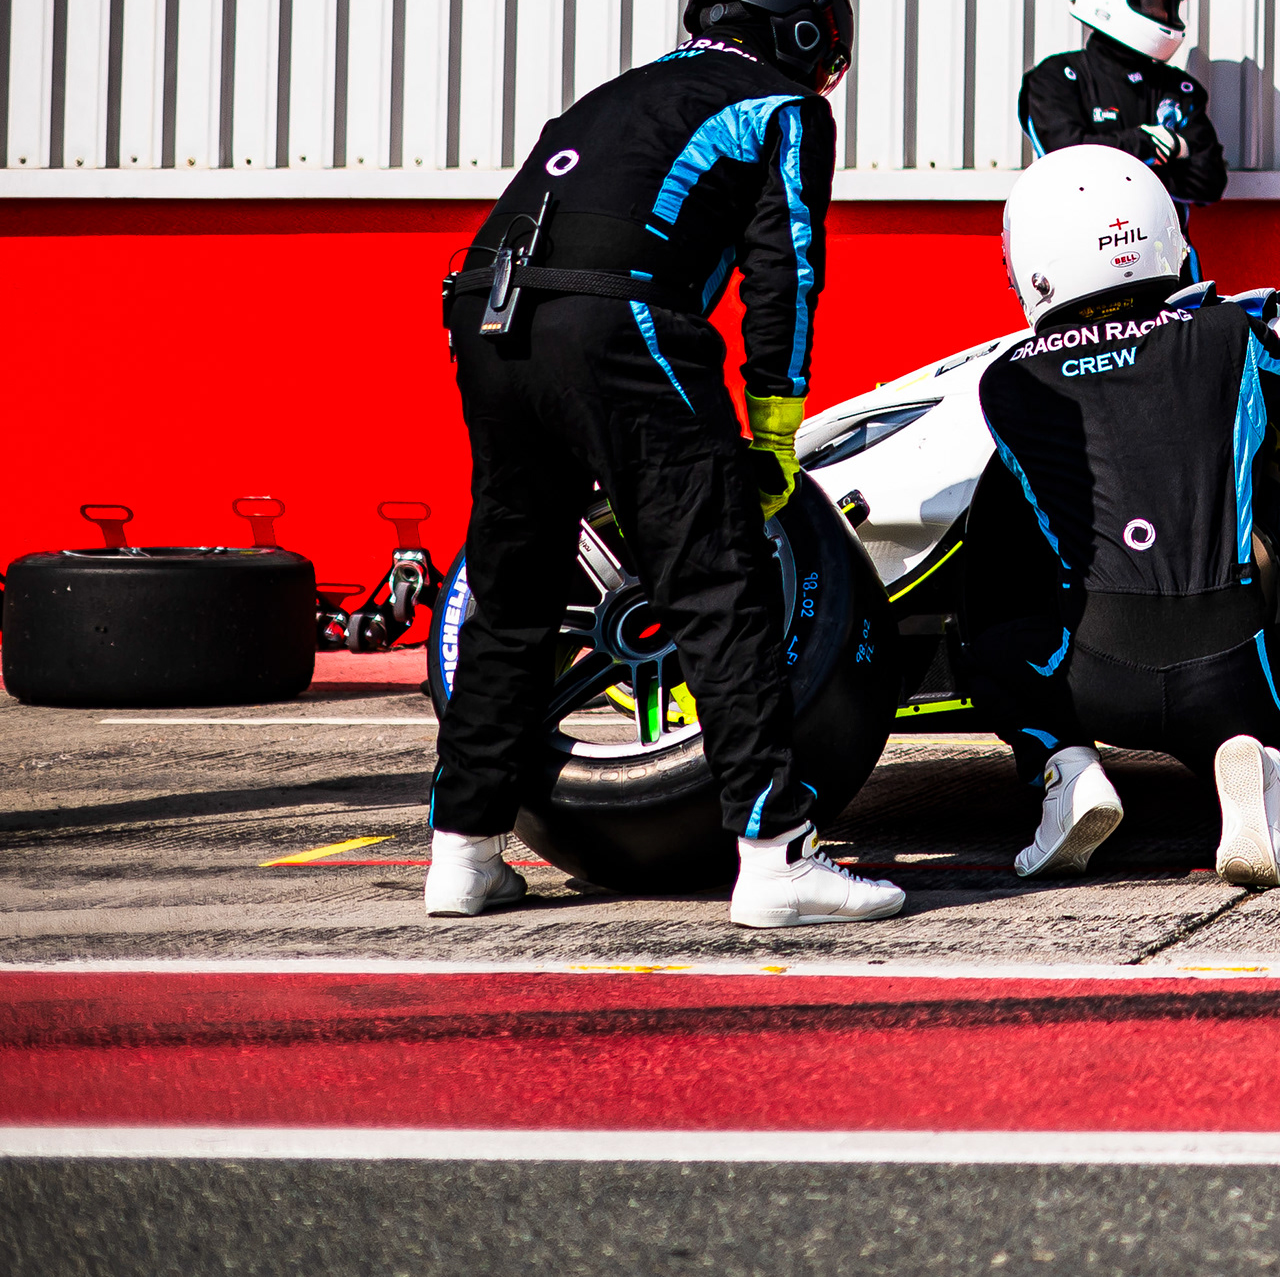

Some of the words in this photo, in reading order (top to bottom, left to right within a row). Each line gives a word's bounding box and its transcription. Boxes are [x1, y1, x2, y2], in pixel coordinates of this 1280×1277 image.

[1098, 227, 1148, 251] PHIL
[1114, 254, 1137, 265] BELL
[1009, 325, 1100, 362] DRAGON
[1061, 347, 1137, 377] CREW
